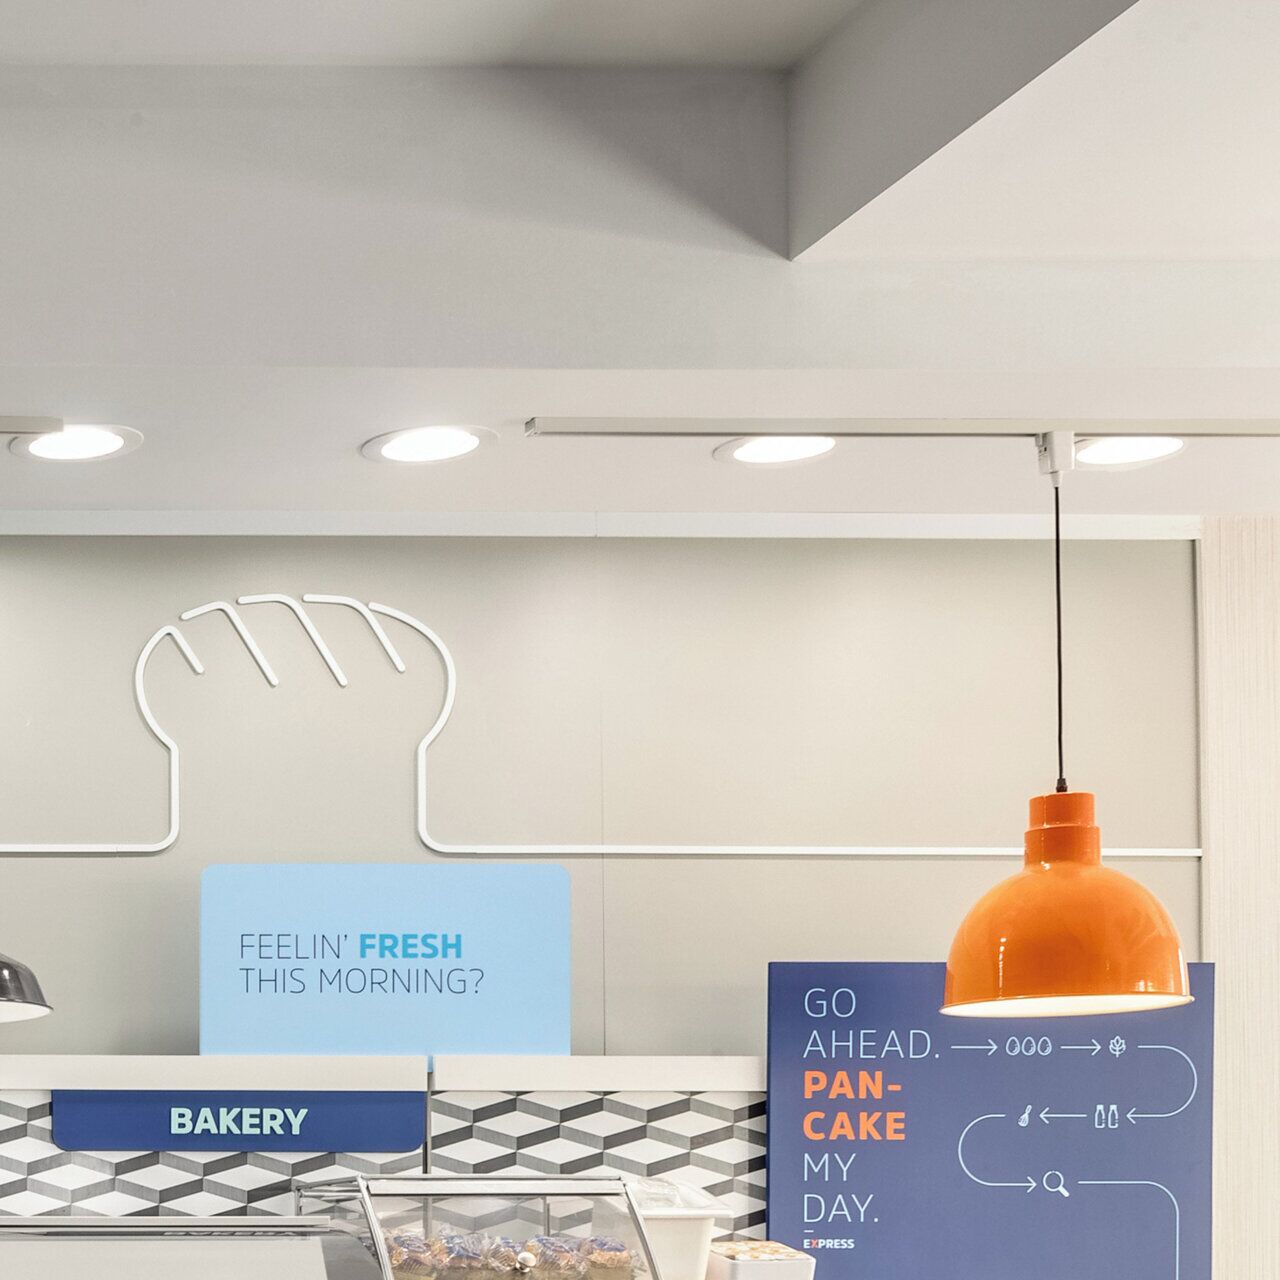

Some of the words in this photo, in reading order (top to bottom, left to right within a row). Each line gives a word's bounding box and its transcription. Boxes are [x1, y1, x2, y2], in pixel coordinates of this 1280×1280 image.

[359, 933, 462, 959] FRESH
[240, 968, 306, 994] THIS
[319, 968, 484, 994] MORNING?
[804, 988, 856, 1018] GO
[803, 1030, 940, 1059] AHEAD.
[804, 1071, 902, 1099] PAN-
[170, 1107, 308, 1136] BAKERY
[803, 1111, 906, 1141] CAKE
[804, 1153, 856, 1181] MY
[804, 1194, 879, 1223] DAY.
[803, 1238, 855, 1249] EXPRESS
